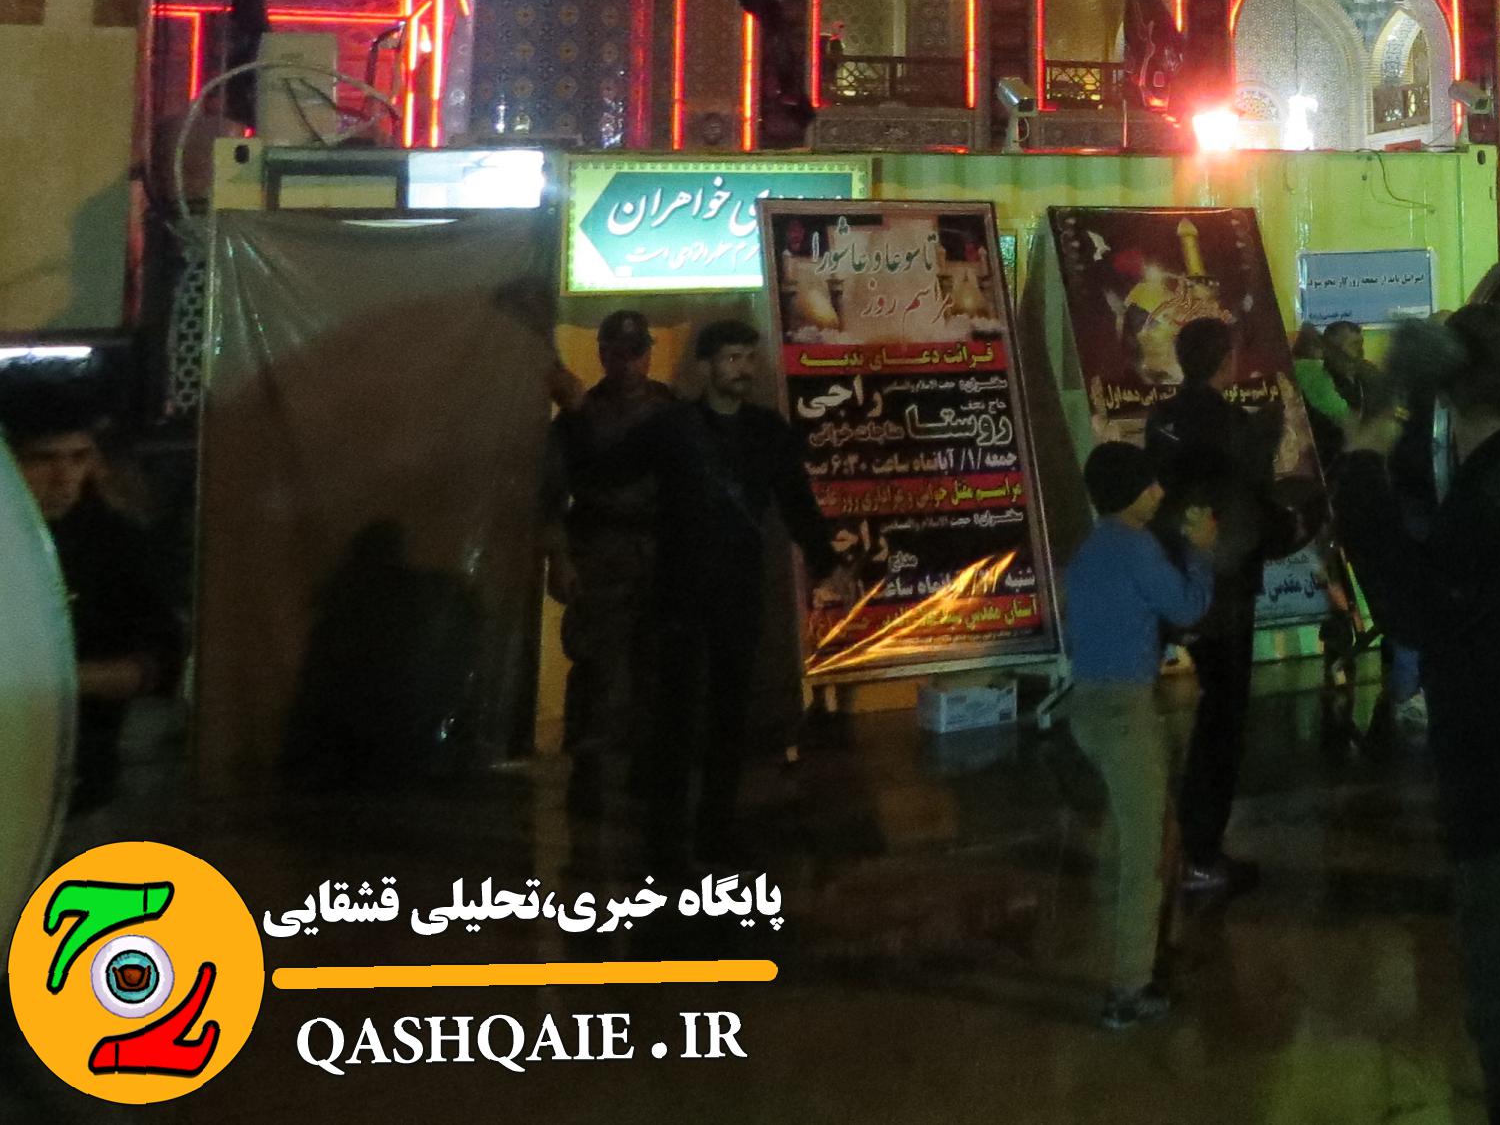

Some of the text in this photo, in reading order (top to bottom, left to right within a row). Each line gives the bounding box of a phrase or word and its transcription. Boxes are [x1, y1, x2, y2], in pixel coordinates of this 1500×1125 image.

[606, 175, 732, 237] خواهران
[811, 215, 939, 274] تاسوعا و عاشورا
[860, 277, 955, 327] مراسم روز
[799, 350, 866, 369] ندبه
[868, 346, 939, 371] دعای
[796, 373, 884, 419] راجی
[904, 404, 1014, 446] روستا
[984, 451, 1018, 471] جمعه
[974, 476, 1025, 504] مراسم
[829, 518, 890, 562] راج
[1004, 566, 1036, 594] شنبه
[1004, 592, 1038, 625] آستان
